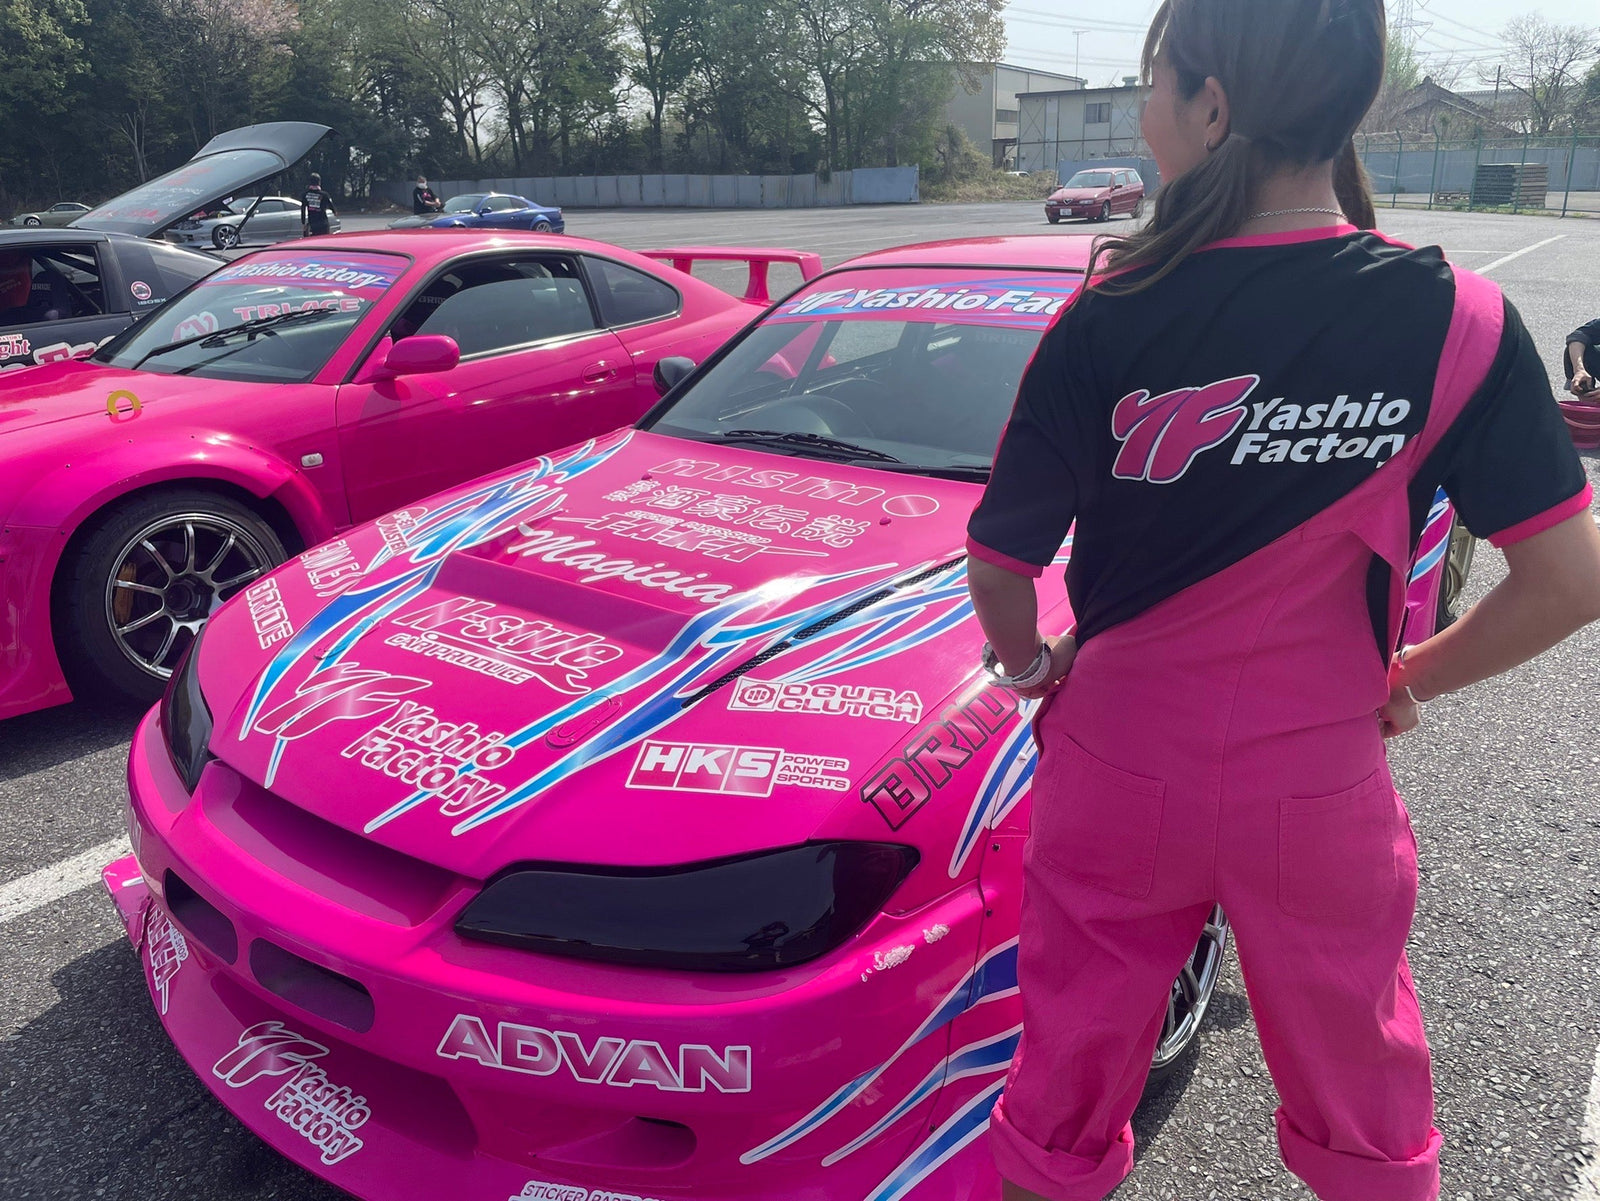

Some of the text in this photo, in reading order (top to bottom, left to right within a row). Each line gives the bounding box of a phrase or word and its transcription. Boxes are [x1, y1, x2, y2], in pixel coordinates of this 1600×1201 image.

[298, 264, 386, 288] Factory
[233, 299, 361, 322] TRI-ACE
[843, 287, 993, 310] Yashio
[985, 289, 1067, 316] Fac
[0, 340, 30, 359] ght
[1247, 392, 1411, 431] Yashio
[1230, 432, 1406, 469] Factory
[245, 577, 294, 650] BRIDE
[391, 596, 624, 669] N-style
[777, 698, 923, 722] CLUTCH
[781, 683, 922, 708] OGURA
[375, 700, 516, 770] Yashio
[639, 746, 774, 778] HKS
[780, 764, 818, 775] AND
[782, 755, 846, 769] POWER
[860, 676, 1019, 832] BRID
[341, 727, 506, 816] Factory
[777, 774, 847, 789] SPORTS
[436, 1013, 752, 1093] ADVAN
[290, 1062, 371, 1130] Yashio
[264, 1083, 364, 1165] Factory
